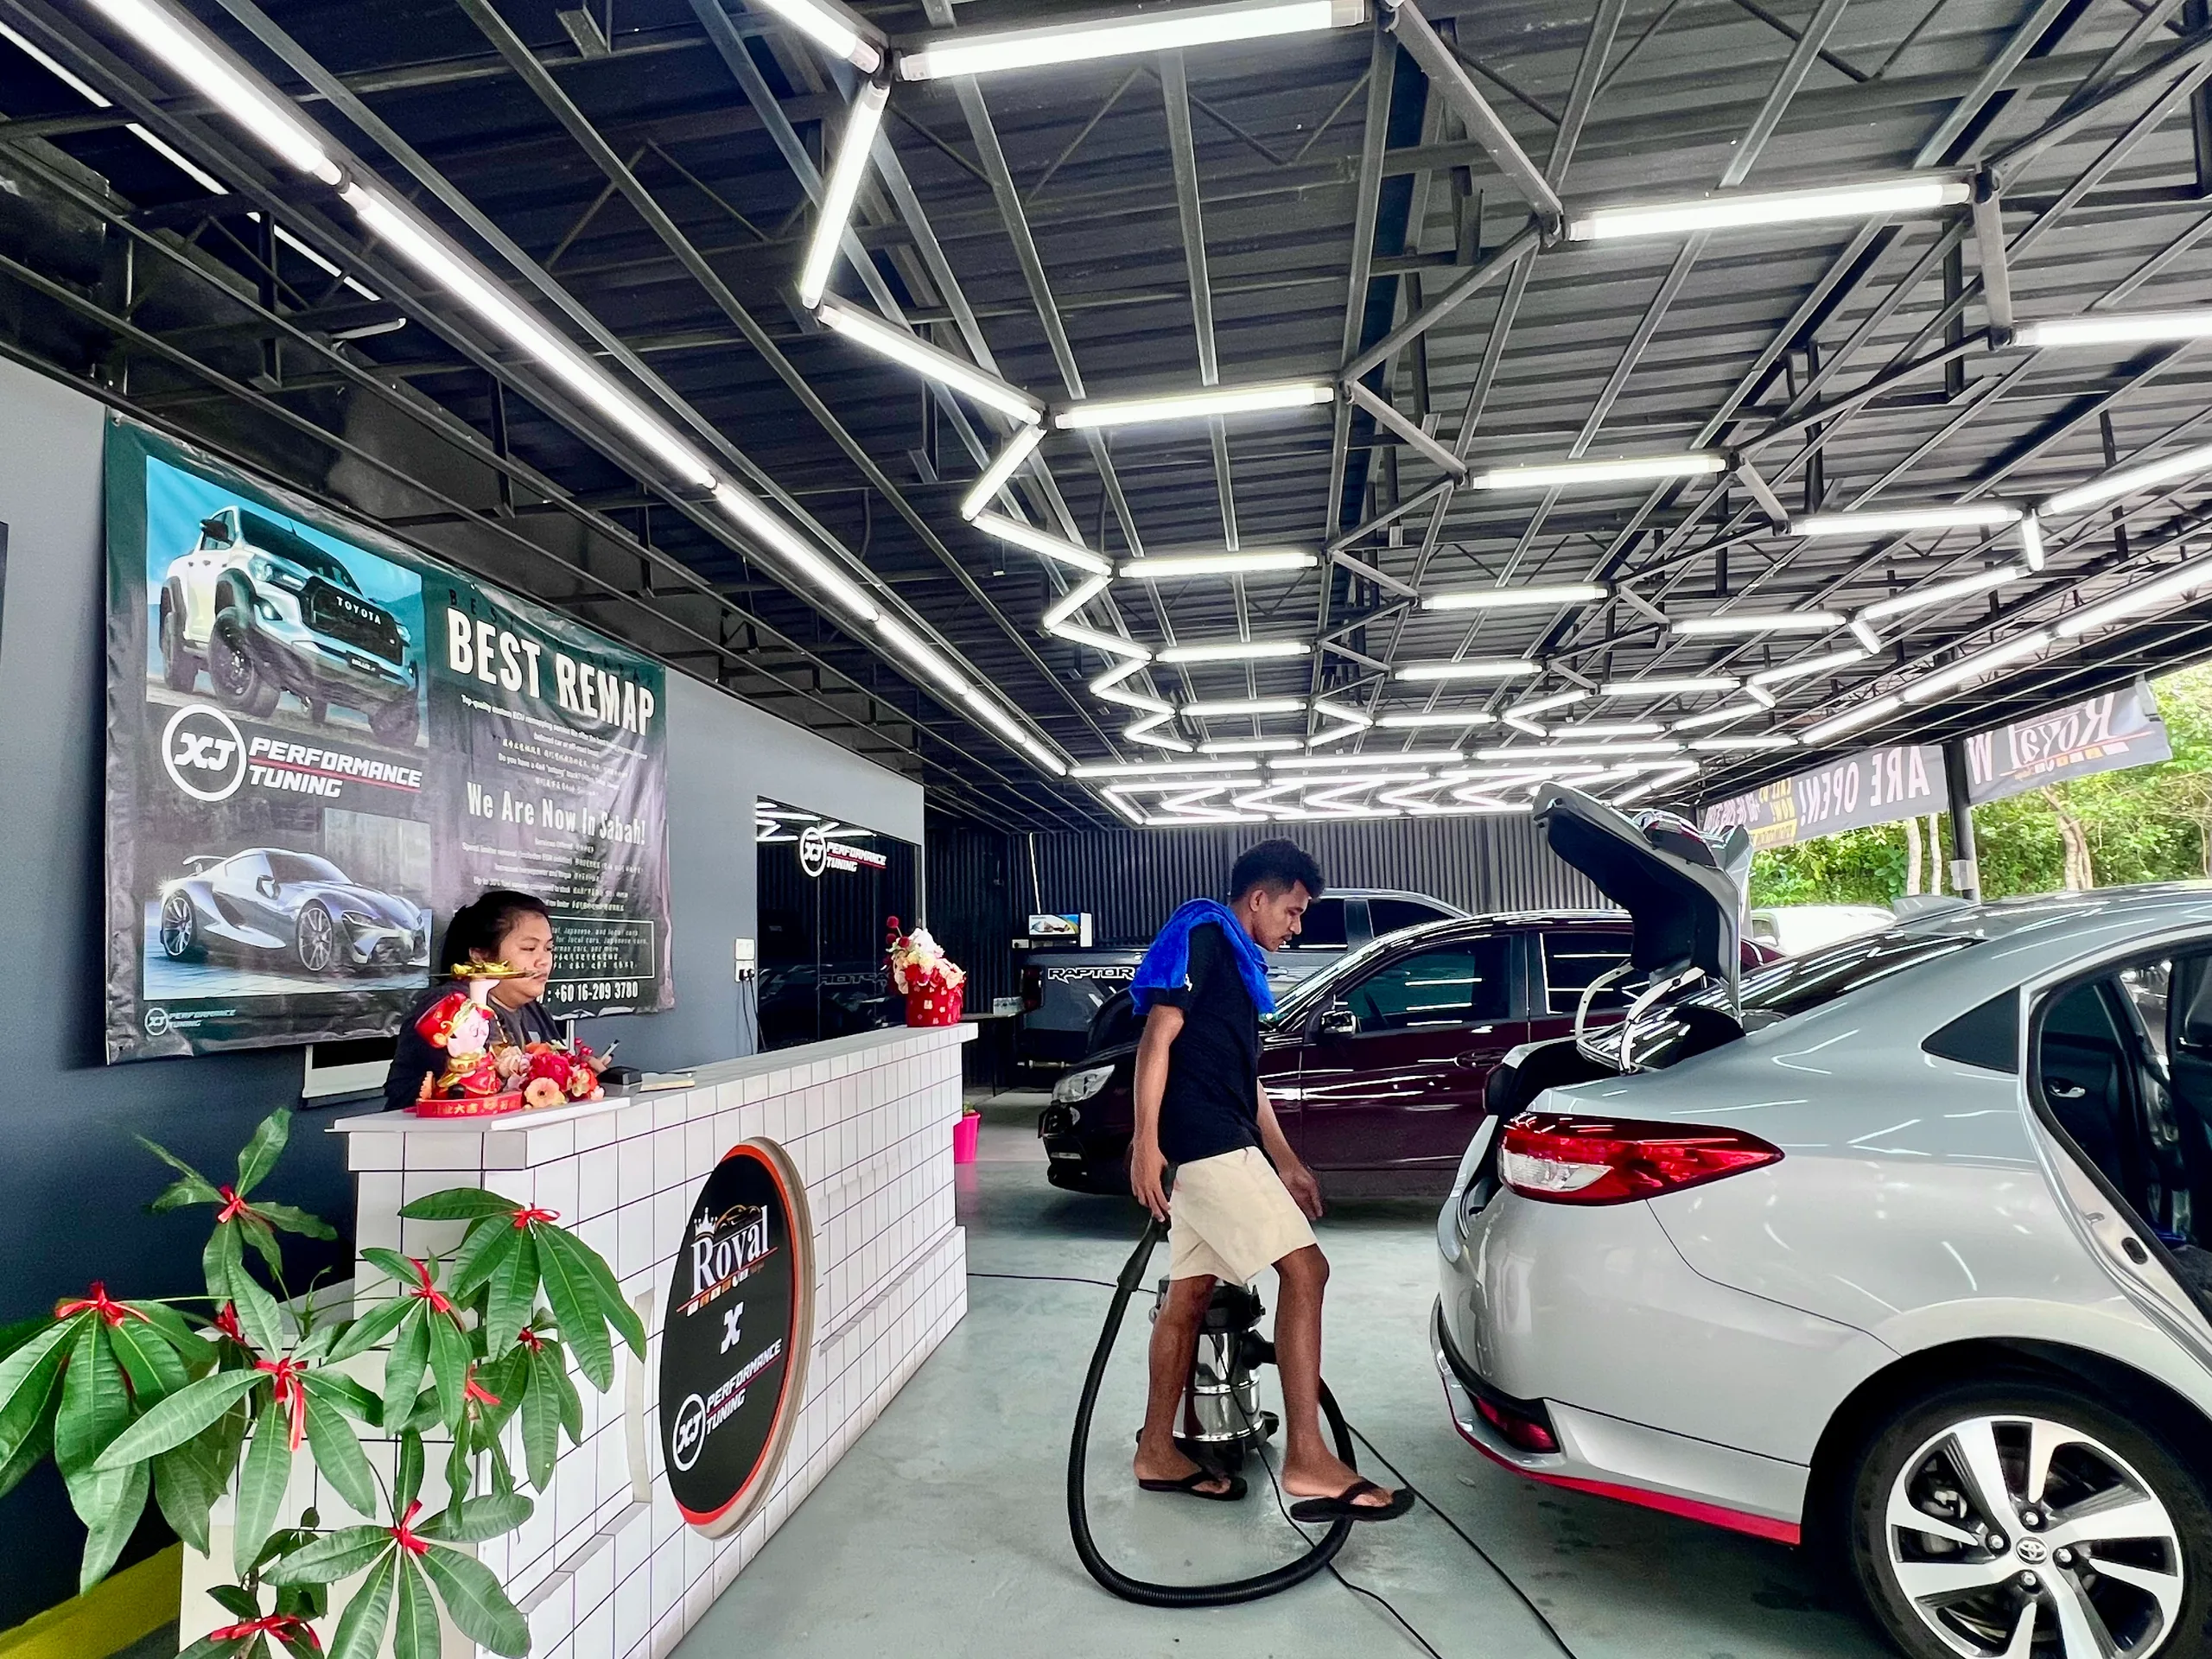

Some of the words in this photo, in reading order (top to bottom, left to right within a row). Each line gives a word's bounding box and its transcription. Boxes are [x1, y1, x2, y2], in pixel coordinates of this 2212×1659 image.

[336, 596, 381, 625] TOYOTA
[448, 607, 540, 698] BEST
[555, 652, 654, 735] REMAP
[175, 732, 236, 772] XJ
[249, 736, 423, 788] PERFORMANCE
[249, 765, 343, 798] TUNING
[467, 781, 493, 818] We
[501, 791, 535, 825] Are
[543, 798, 576, 832] Now
[582, 807, 595, 836] In
[600, 811, 645, 845] Sabah!
[826, 856, 858, 872] TUNING
[827, 841, 887, 866] PERFORMANCE
[555, 983, 575, 1002] +60
[577, 982, 611, 1001] 16-209
[614, 981, 639, 1000] 3780
[1047, 967, 1137, 984] RAPTOR
[168, 1009, 236, 1020] PERFORMANCE
[168, 1020, 202, 1028] TUNING
[690, 1205, 769, 1299] Royal
[707, 1338, 783, 1413] PERFORMANCE
[707, 1388, 746, 1435] TUNING
[677, 1411, 702, 1454] XJ
